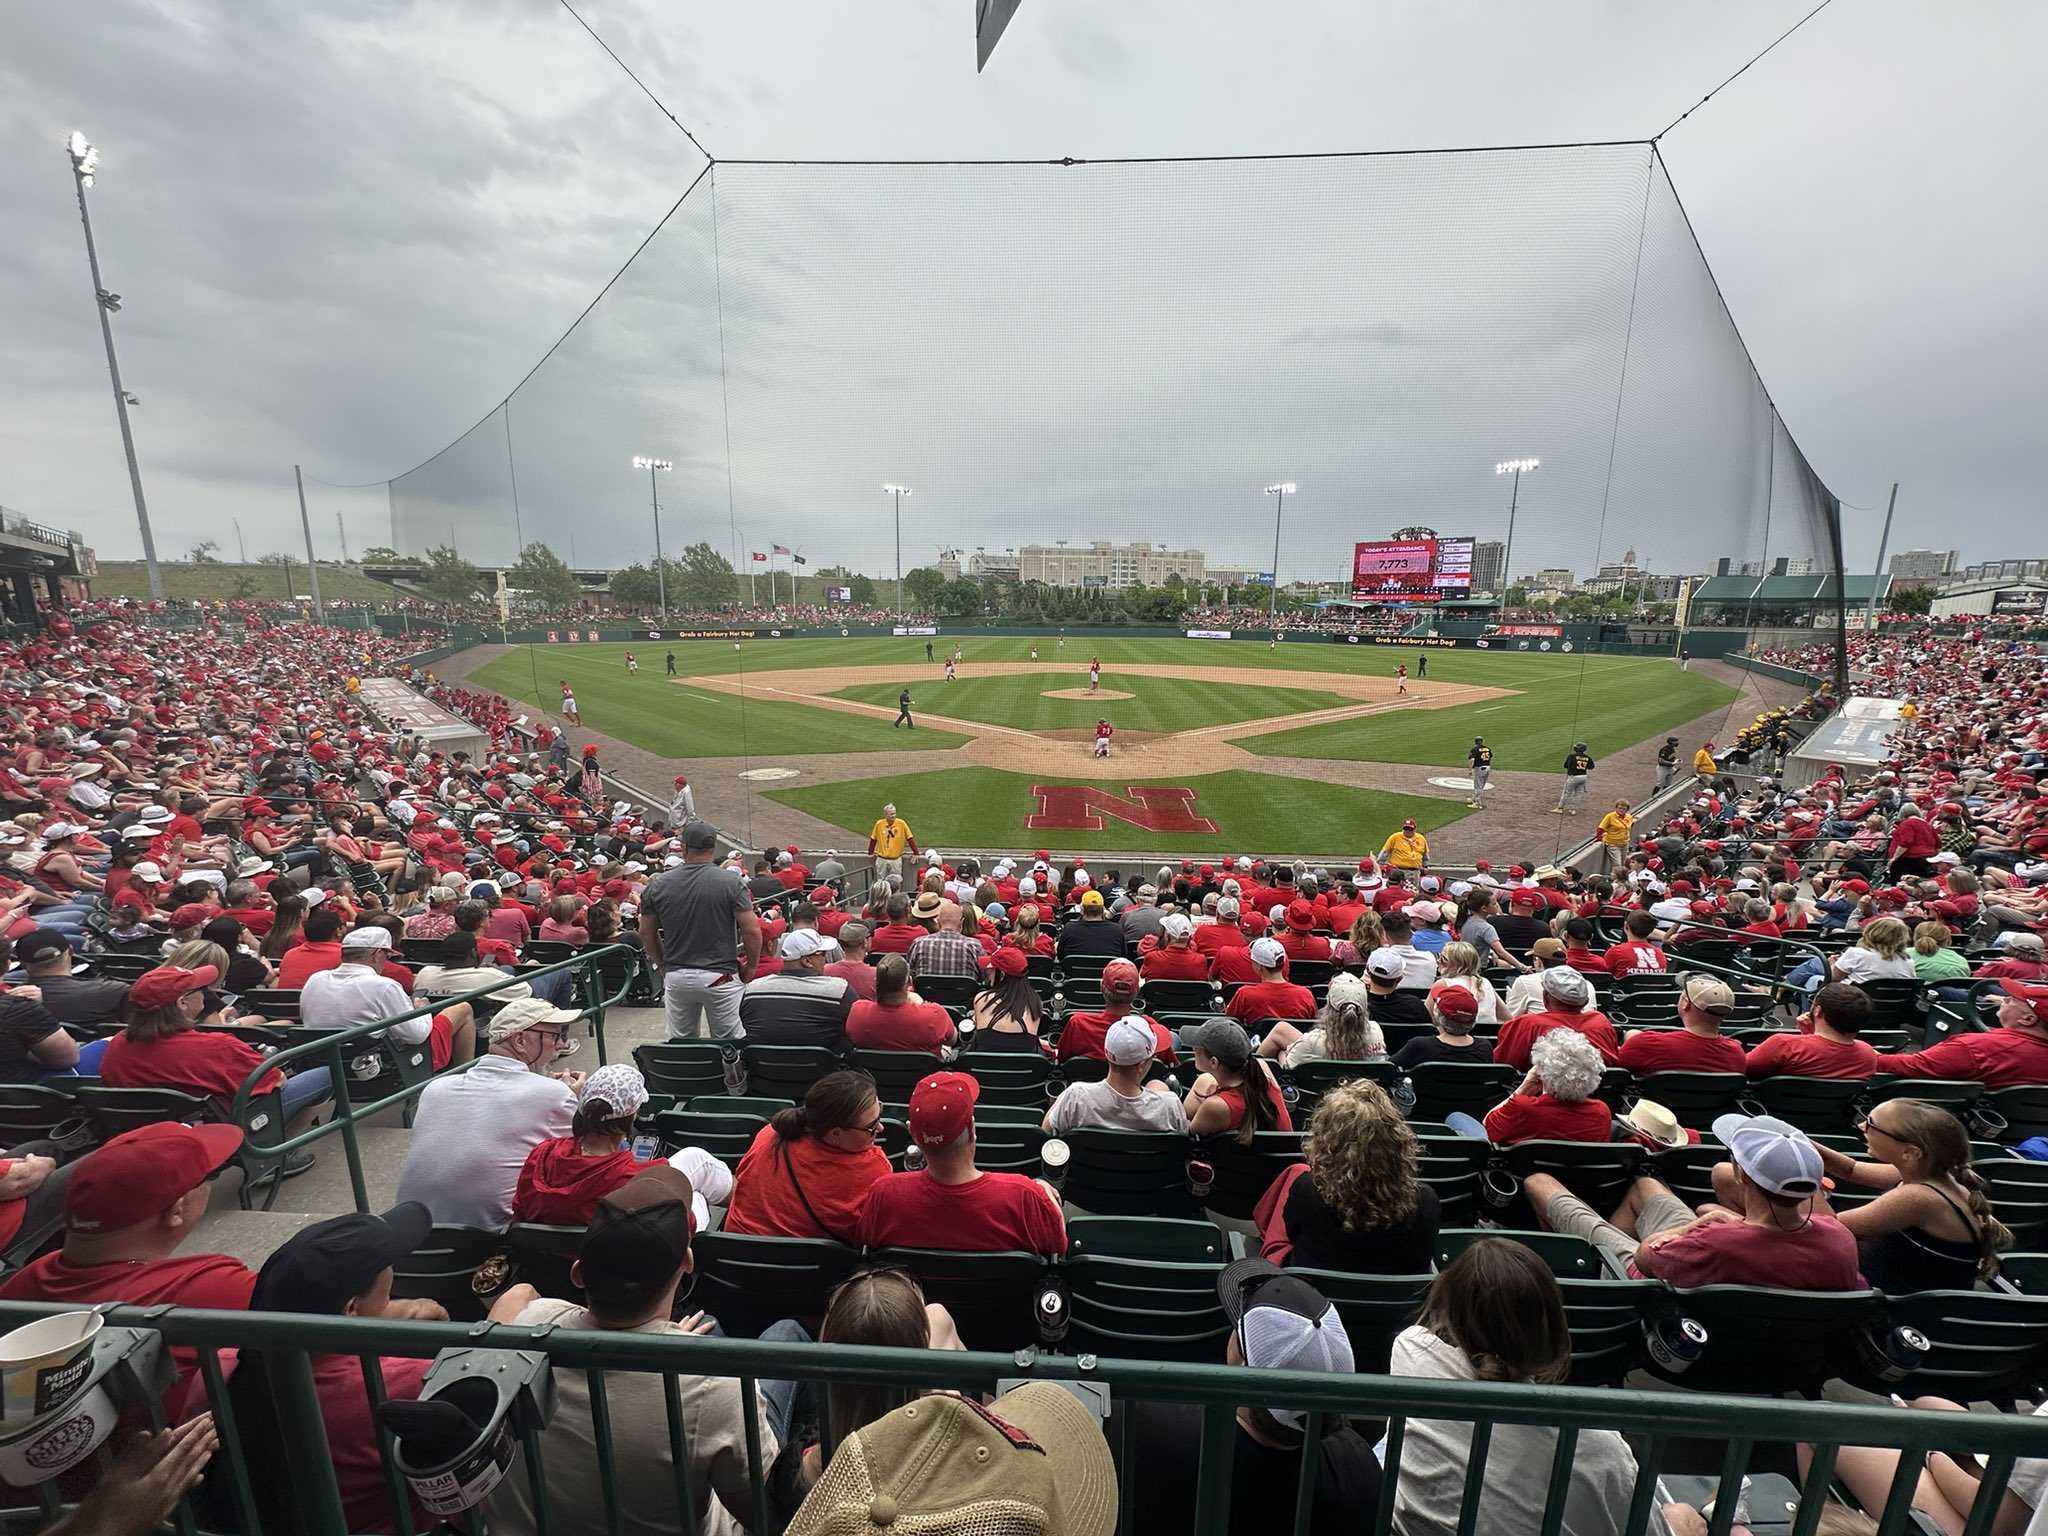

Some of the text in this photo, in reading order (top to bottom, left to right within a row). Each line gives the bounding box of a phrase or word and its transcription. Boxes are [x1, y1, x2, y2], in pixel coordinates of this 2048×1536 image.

[1378, 559, 1409, 570] 7,773
[703, 631, 728, 639] Fairbury
[1398, 638, 1425, 646] Fairbury
[1440, 639, 1456, 647] Dog!
[1028, 785, 1217, 833] N
[1632, 947, 1661, 968] N
[44, 1358, 89, 1385] Minute
[49, 1368, 82, 1392] Maid
